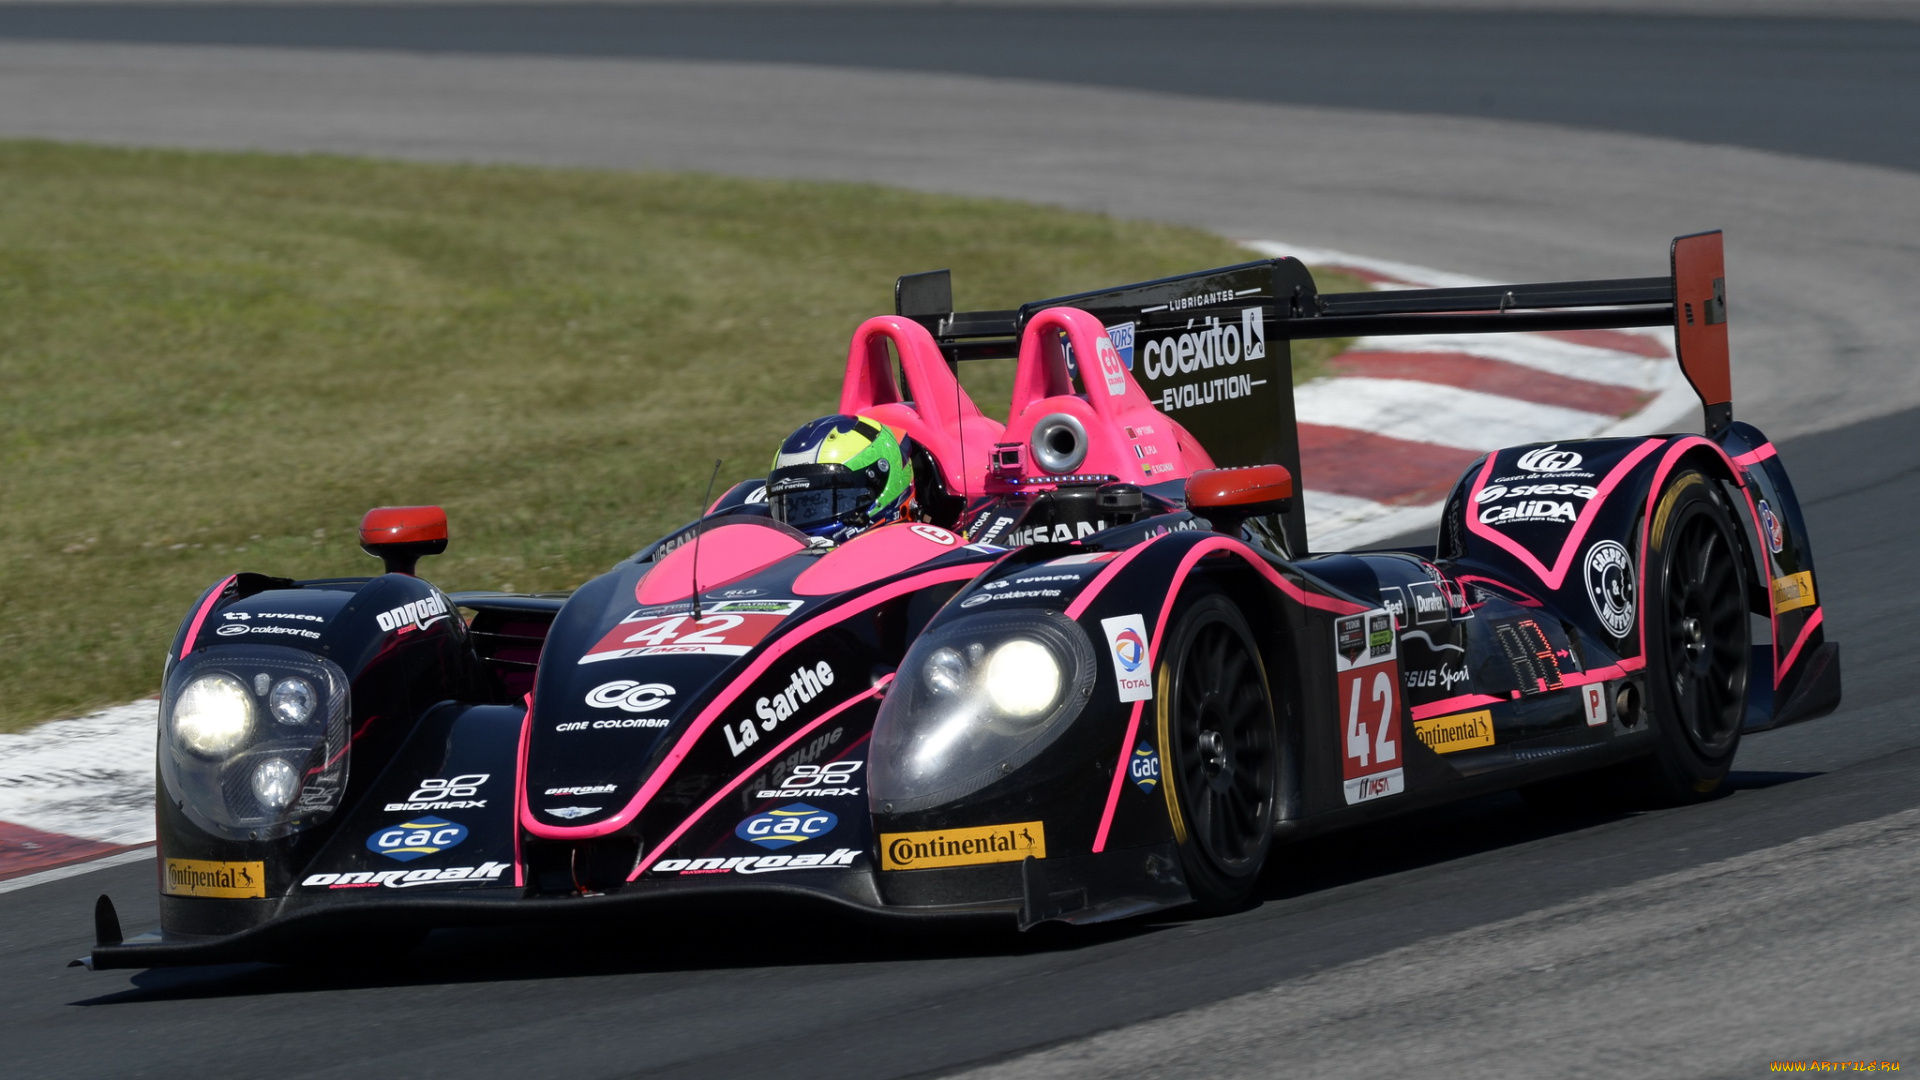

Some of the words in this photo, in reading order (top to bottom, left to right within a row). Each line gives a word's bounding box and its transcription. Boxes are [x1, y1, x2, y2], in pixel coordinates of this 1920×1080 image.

[1169, 289, 1234, 311] LUBRICANTES
[1143, 316, 1241, 380] coéxito
[1163, 373, 1252, 412] EVOLUTION
[1526, 472, 1541, 480] de
[1592, 547, 1627, 573] CREPES
[257, 612, 325, 623] TUVACOL
[623, 614, 746, 646] 42
[250, 625, 321, 640] coldeportes
[722, 718, 759, 758] La
[755, 660, 835, 732] Sarthe
[1346, 671, 1397, 768] 42
[555, 720, 589, 732] CINE
[592, 717, 670, 730] COLOMBIA
[756, 786, 861, 798] BIOMAX
[384, 799, 489, 812] BIOMAX
[889, 830, 1018, 866] Continental
[168, 863, 237, 890] Continental
